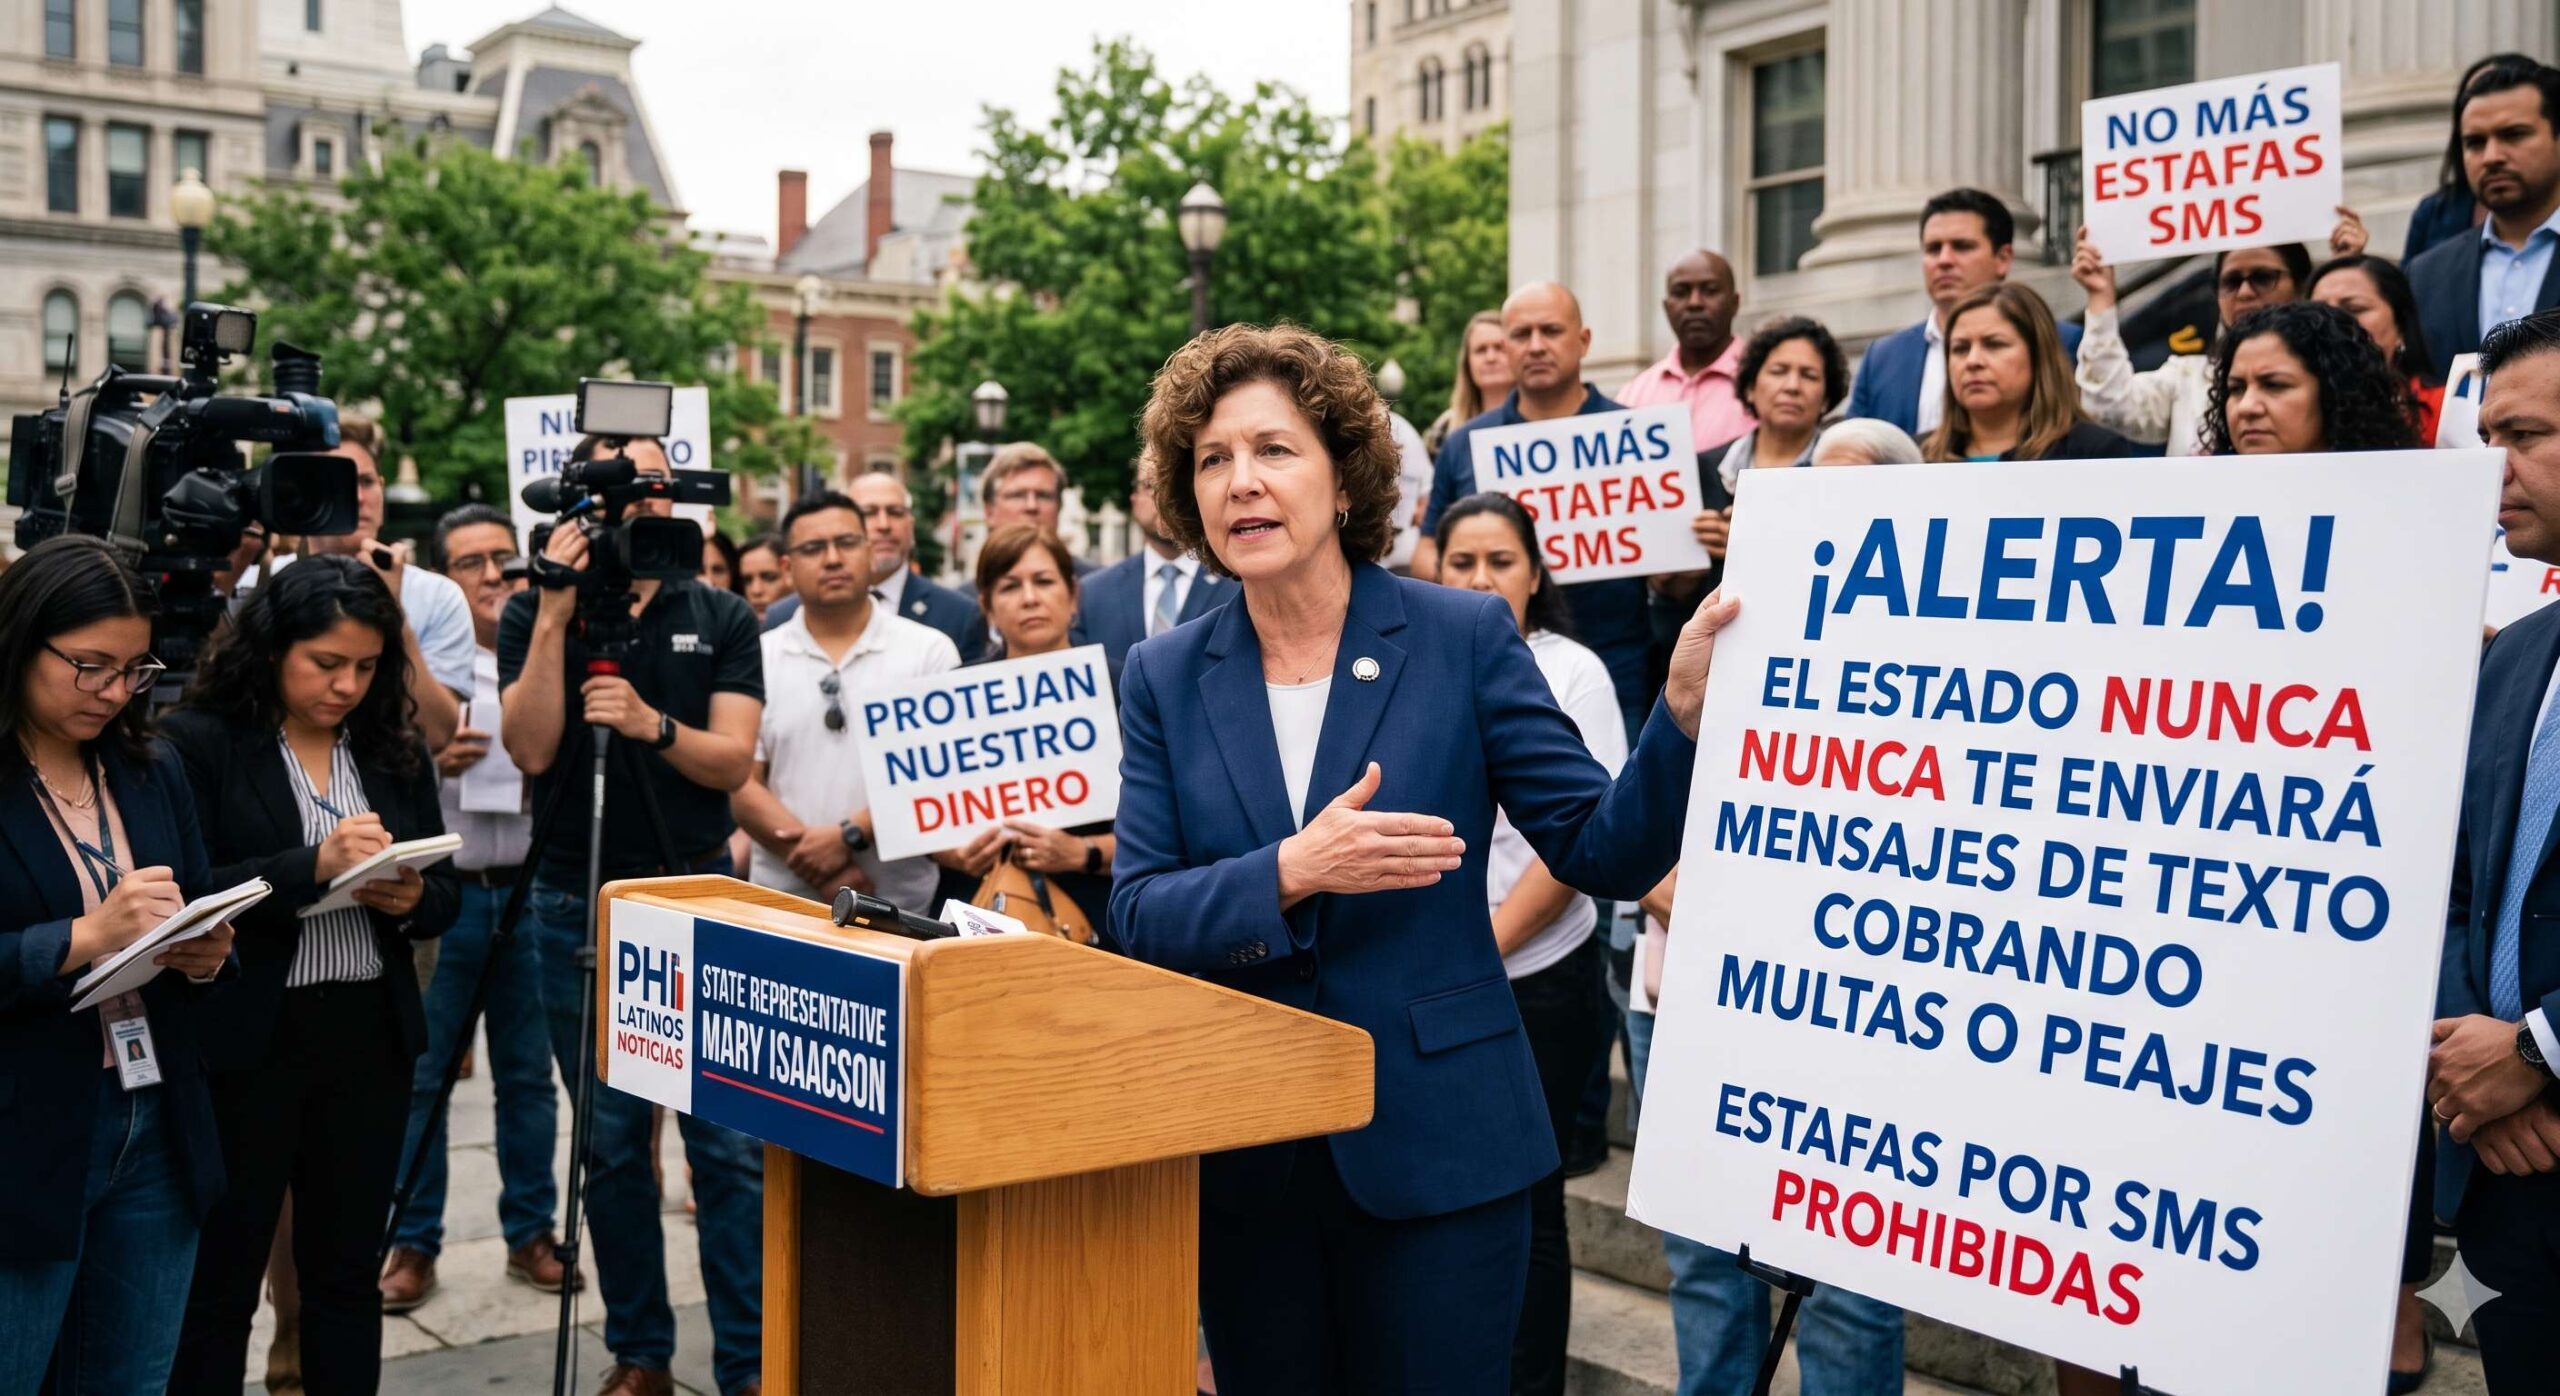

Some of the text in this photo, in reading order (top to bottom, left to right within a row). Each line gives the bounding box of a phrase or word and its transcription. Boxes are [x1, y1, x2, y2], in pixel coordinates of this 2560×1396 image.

[2107, 82, 2310, 150] NO MÁS
[2095, 134, 2323, 201] ESTAFAS
[2149, 195, 2262, 245] SMS
[1494, 418, 1670, 478] NO MÁS
[1504, 471, 1685, 523] STAFAS
[1544, 526, 1642, 571] SMS
[1804, 515, 2335, 641] ¡ALERTA!
[864, 663, 1097, 737] PROTEJAN
[1761, 656, 2372, 751] EL ESTADO NUNCA
[885, 717, 1097, 785] NUESTRO
[913, 770, 1089, 833] DINERO
[1739, 729, 2382, 848] NUNCA TE ENVIARÁ
[1714, 800, 2390, 942] MENSAJES DE TEXTO
[1813, 892, 2203, 1008] COBRANDO
[617, 1001, 684, 1042] LATINOS
[702, 964, 887, 1047] STATE REPRESENTATIVE
[1717, 953, 2317, 1126] MULTAS O PEAJES
[617, 1030, 684, 1070] NOTICIAS
[702, 1010, 886, 1115] MARY ISAACSON
[1715, 1082, 2263, 1272] ESTAFAS POR SMS
[1771, 1168, 2144, 1326] PROHIBIDAS
